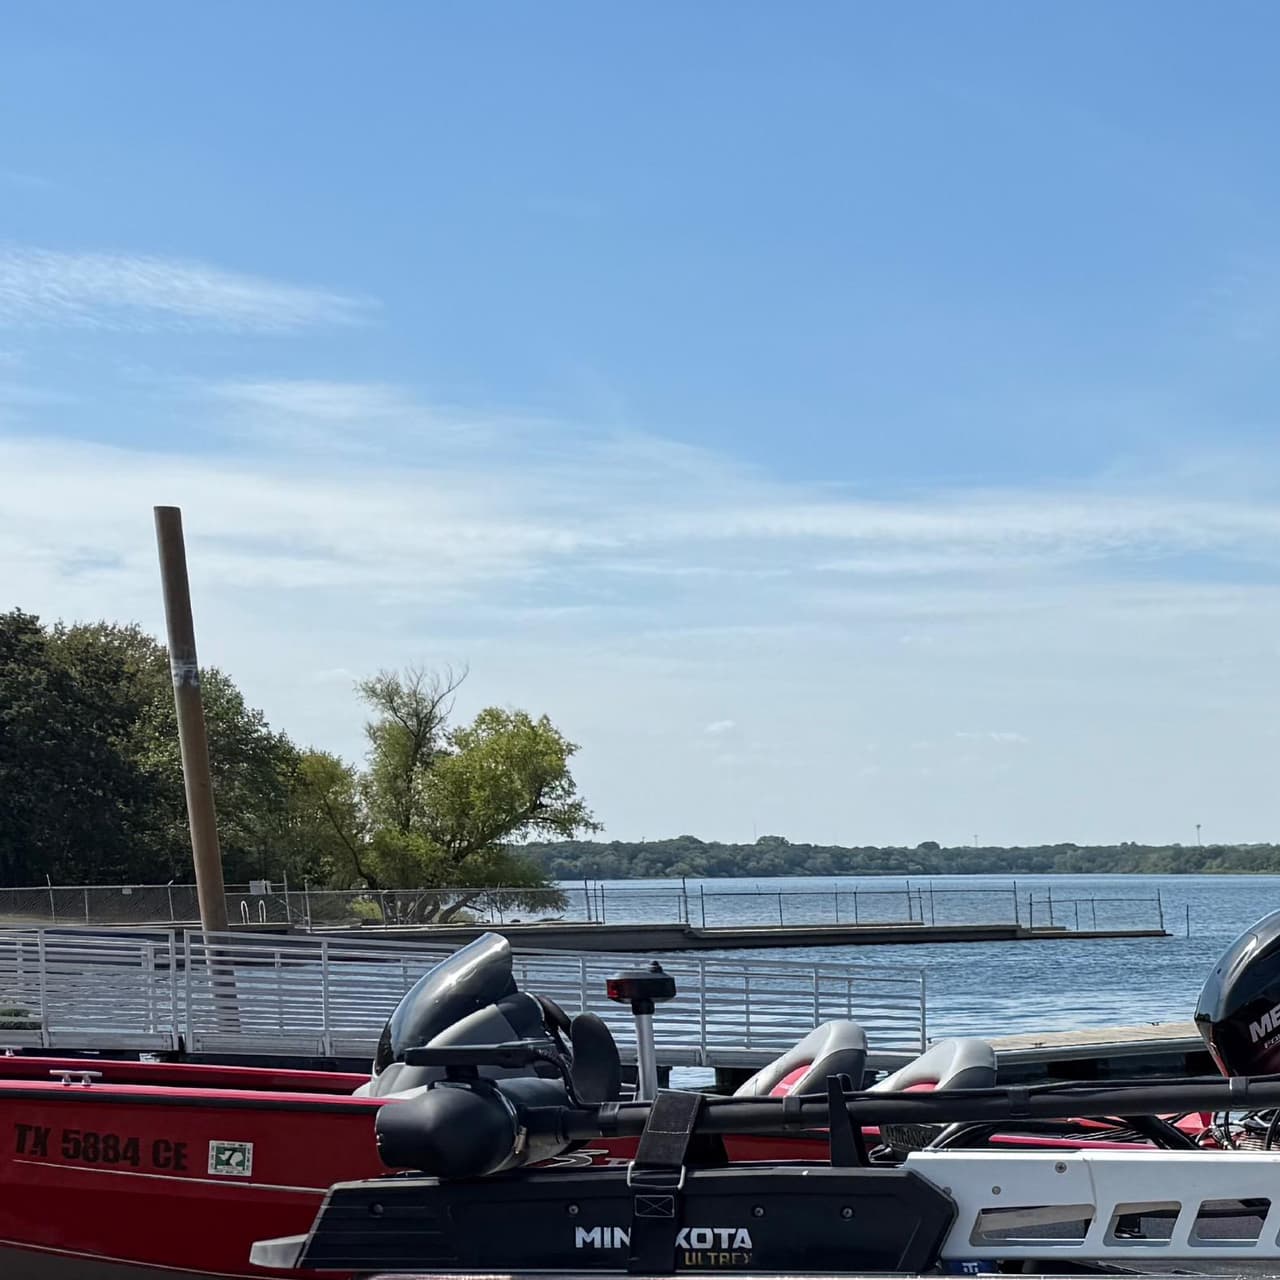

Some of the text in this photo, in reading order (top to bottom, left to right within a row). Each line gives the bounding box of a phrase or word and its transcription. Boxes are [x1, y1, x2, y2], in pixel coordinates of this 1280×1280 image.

[14, 1123, 51, 1157] TX
[62, 1129, 140, 1167] 5884
[152, 1139, 188, 1171] CE
[575, 1226, 632, 1249] MIN
